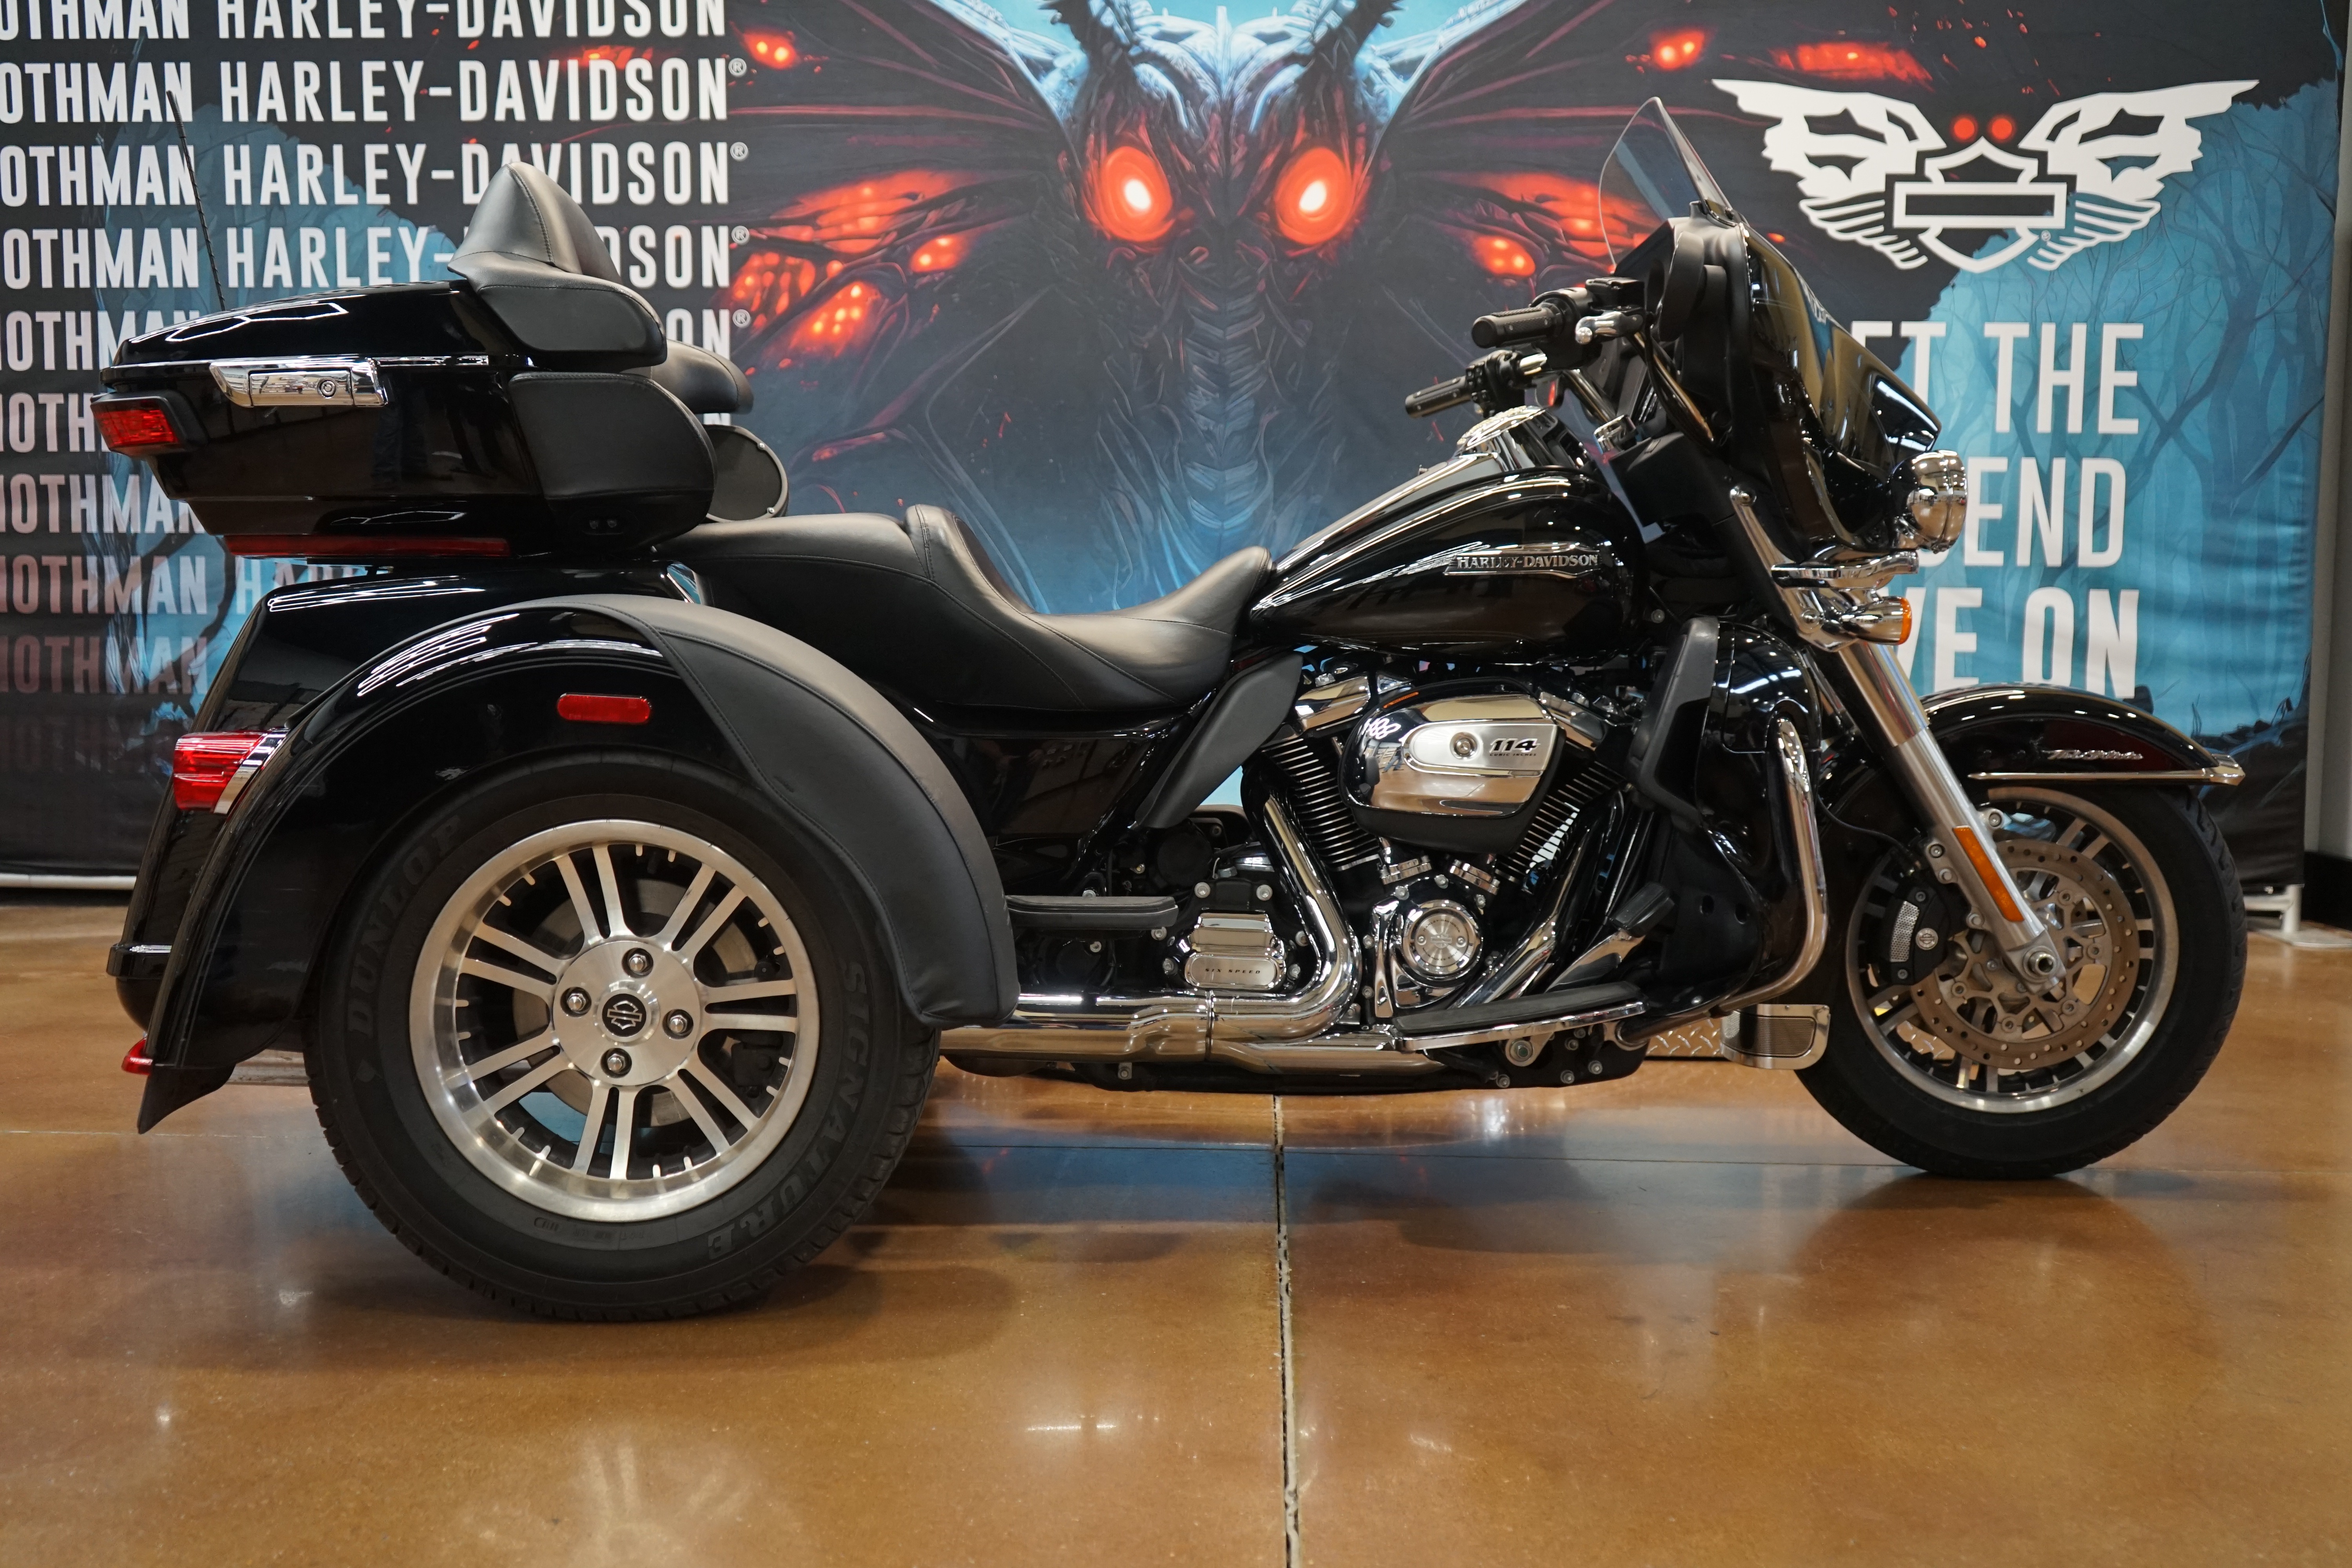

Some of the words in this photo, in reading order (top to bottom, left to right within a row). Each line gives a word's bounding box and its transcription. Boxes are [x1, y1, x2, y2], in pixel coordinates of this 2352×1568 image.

[4, 228, 199, 289] OTHMAN
[1984, 322, 2143, 434] THE
[1918, 457, 2126, 568] END
[0, 555, 208, 615] OTHMAN
[1457, 554, 1599, 569] HARLEY-DAVIDSON
[0, 635, 208, 695] OTHMAN
[2022, 586, 2140, 699] ON
[1490, 739, 1537, 753] 114
[347, 815, 461, 1038] DUNLOP
[707, 960, 871, 1261] SIGNATURE
